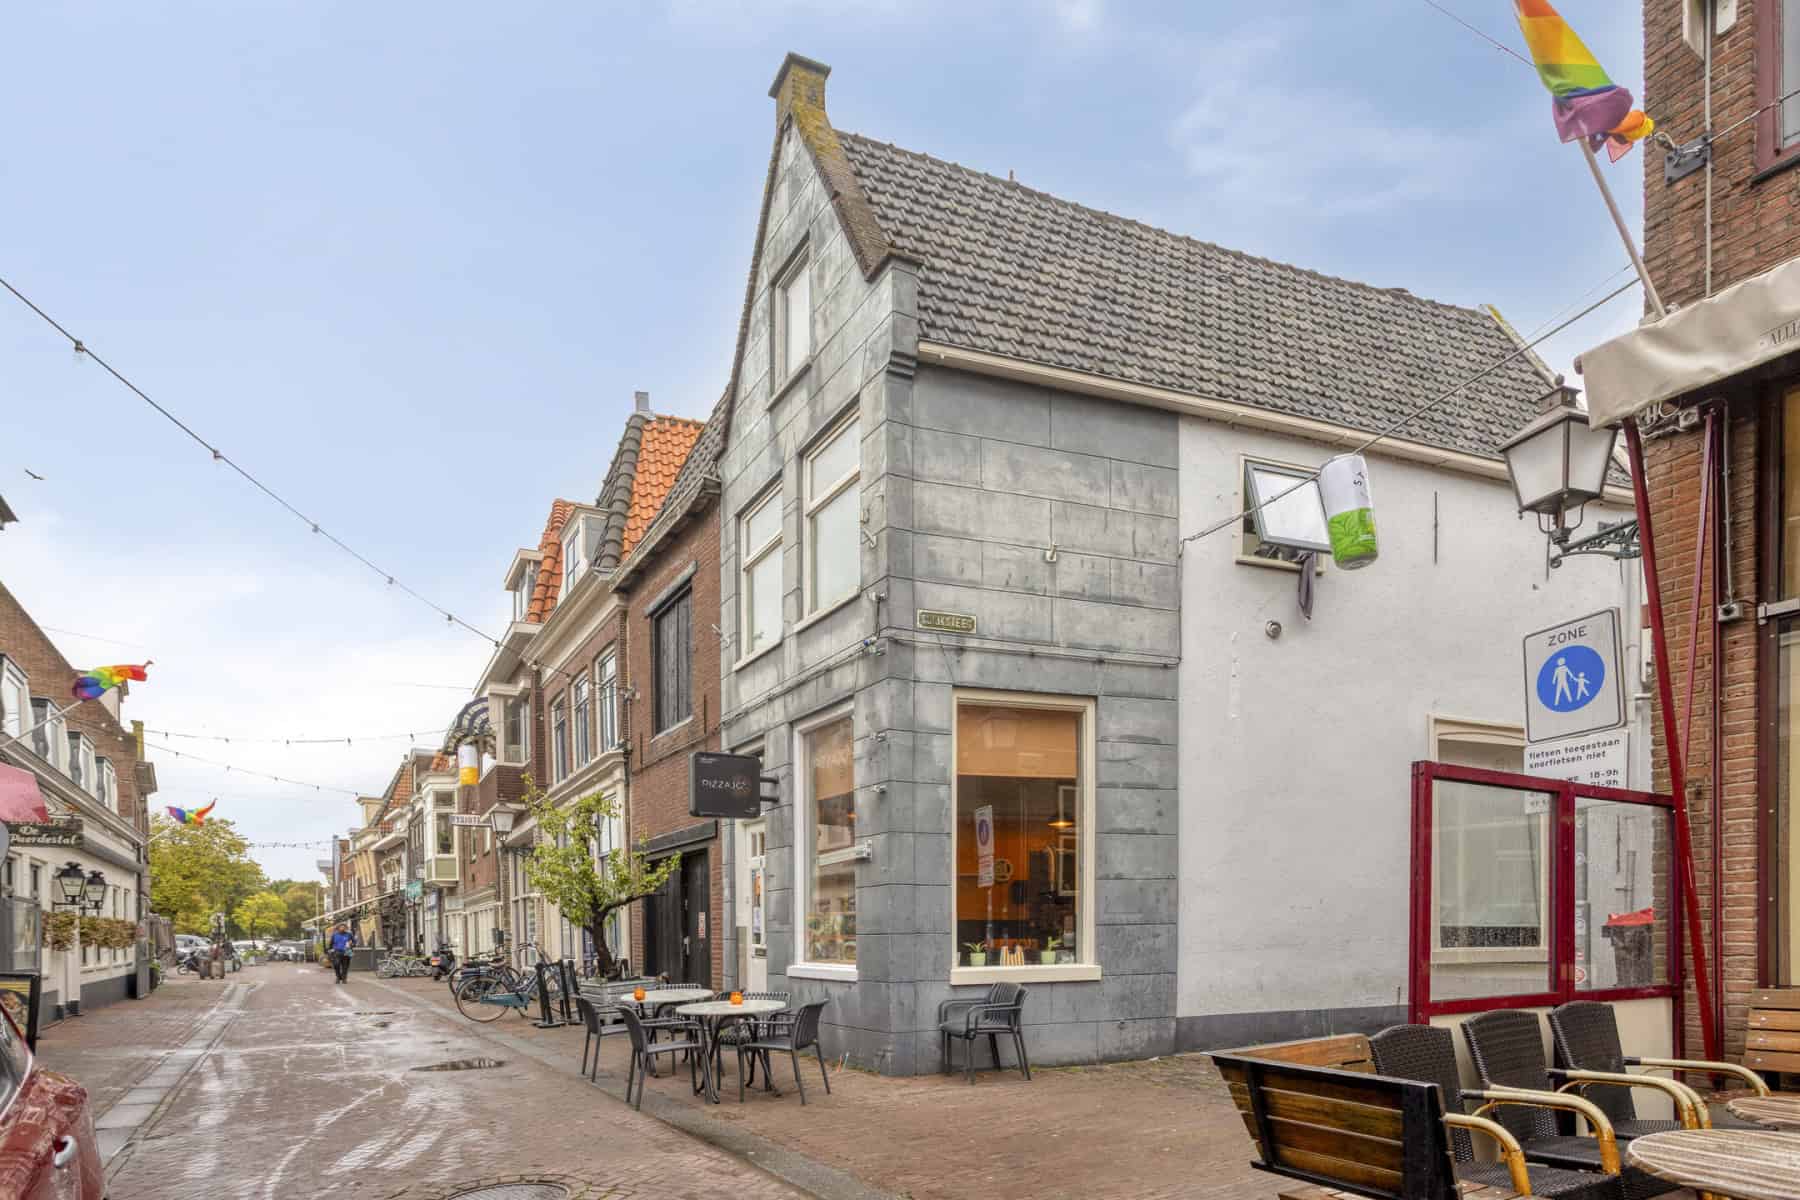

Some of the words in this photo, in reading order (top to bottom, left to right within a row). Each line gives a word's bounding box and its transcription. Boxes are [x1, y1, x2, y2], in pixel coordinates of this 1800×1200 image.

[1548, 625, 1588, 647] ZONE
[1529, 749, 1561, 760] fietsen
[1565, 738, 1620, 754] toegestaan
[1529, 755, 1582, 769] snorfietsen
[1586, 750, 1607, 761] niet
